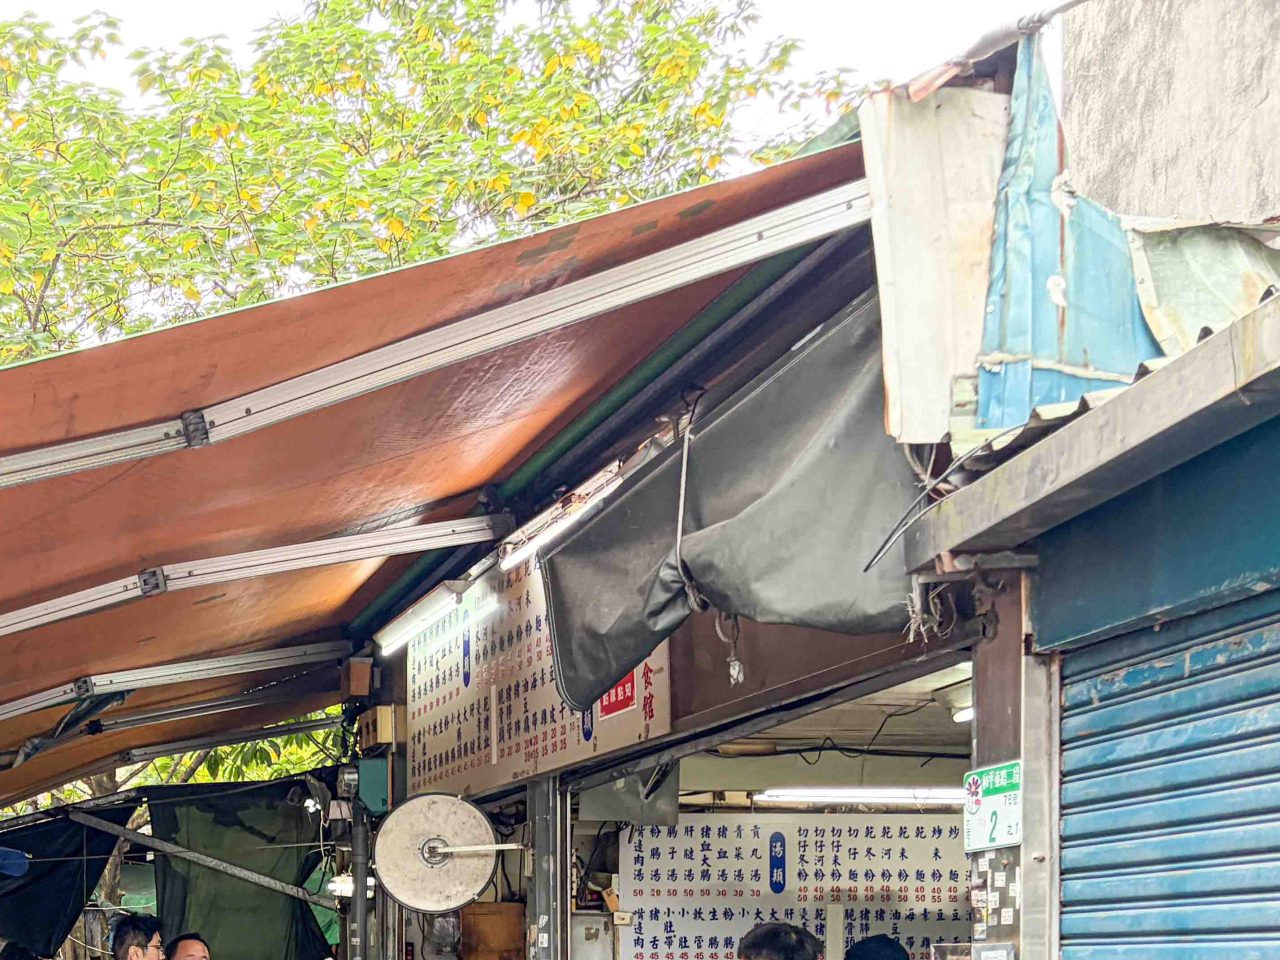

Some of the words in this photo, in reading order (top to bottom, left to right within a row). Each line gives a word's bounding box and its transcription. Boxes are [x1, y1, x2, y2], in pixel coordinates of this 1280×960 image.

[988, 810, 998, 843] 2
[650, 825, 662, 882] 粉腸湯
[667, 825, 678, 882] 腸子湯
[733, 825, 744, 882] 青菜湯
[750, 825, 762, 882] 貢丸湯
[797, 825, 809, 882] 切仔冬粉
[813, 825, 826, 882] 切仔河粉
[864, 825, 876, 882] 乾冬粉
[880, 825, 893, 882] 乾河粉
[772, 841, 784, 885] 湯類
[633, 889, 644, 897] 50
[667, 889, 677, 897] 50
[683, 889, 694, 897] 50
[700, 889, 710, 897] 50
[733, 889, 744, 897] 30
[750, 889, 761, 897] 30
[797, 894, 808, 902] 50
[813, 894, 824, 902] 50
[831, 894, 841, 902] 50
[847, 894, 858, 902] 50
[864, 894, 875, 902] 50
[881, 894, 891, 902] 50
[897, 894, 908, 902] 50
[915, 894, 926, 902] 50
[931, 895, 942, 903] 55
[678, 907, 690, 949] 小肚
[708, 907, 719, 949] 生腸
[722, 907, 735, 949] 粉腸
[905, 908, 915, 950] 海帶
[634, 952, 644, 960] 45
[649, 952, 659, 960] 45
[665, 952, 674, 960] 45
[679, 952, 689, 960] 45
[694, 952, 704, 960] 45
[709, 952, 719, 960] 45
[723, 952, 734, 960] 45
[920, 952, 930, 960] 20
